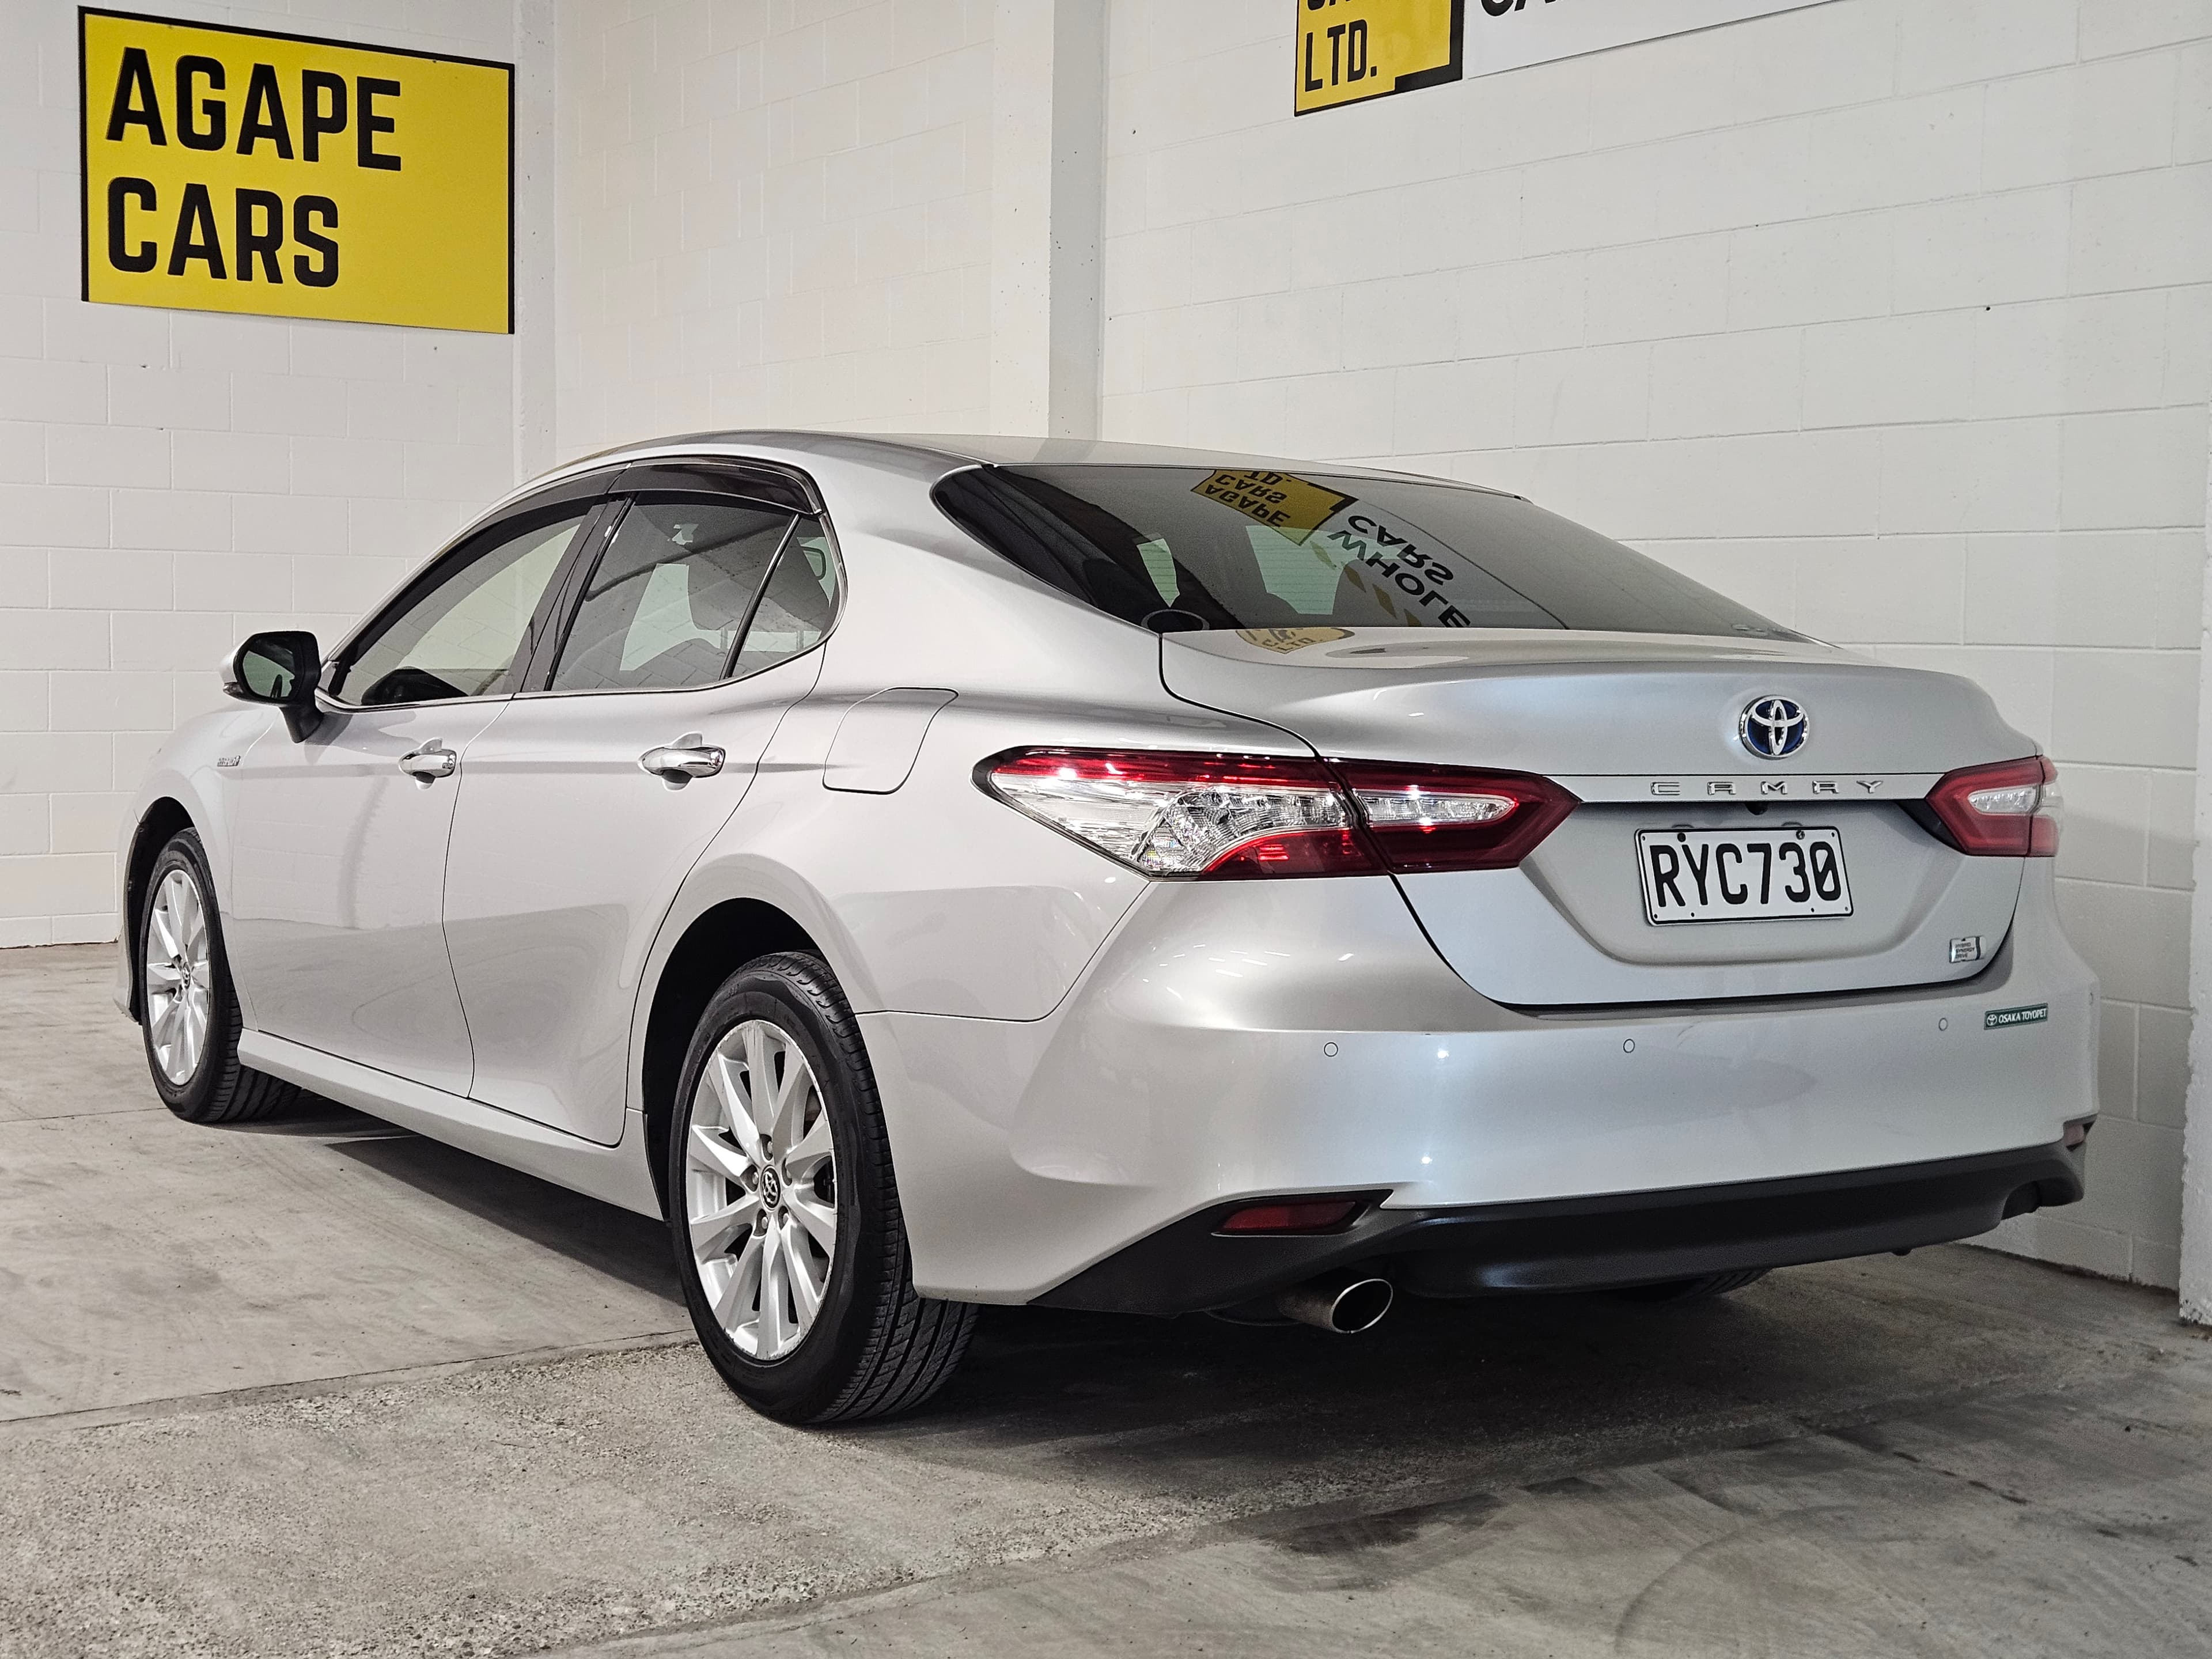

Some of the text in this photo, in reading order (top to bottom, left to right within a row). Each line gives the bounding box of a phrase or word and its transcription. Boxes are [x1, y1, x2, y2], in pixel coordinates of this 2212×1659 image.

[1305, 19, 1377, 92] LTD.
[106, 47, 402, 171] AGAPE
[107, 176, 339, 288] CARS
[1650, 780, 1884, 796] CAMRY
[1649, 841, 1842, 908] RYC730
[1998, 1008, 2047, 1024] OSAKA TOYOPET
